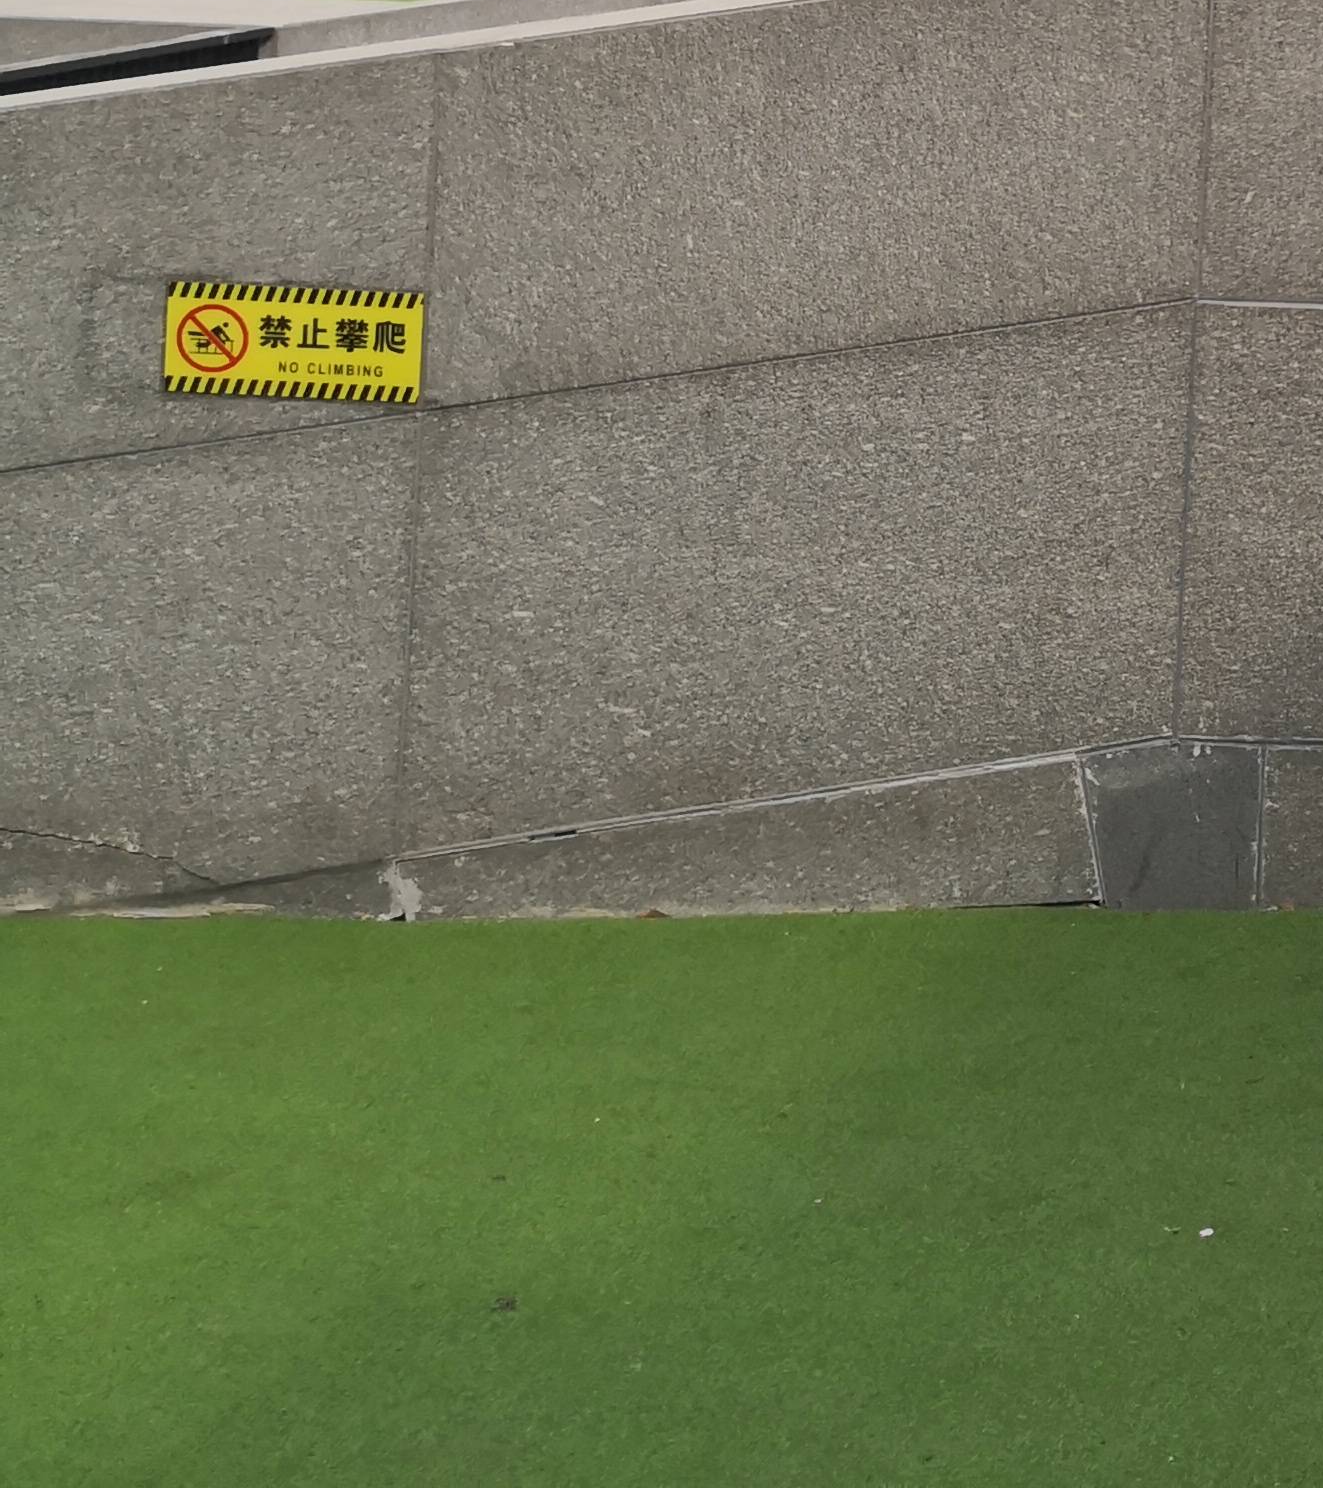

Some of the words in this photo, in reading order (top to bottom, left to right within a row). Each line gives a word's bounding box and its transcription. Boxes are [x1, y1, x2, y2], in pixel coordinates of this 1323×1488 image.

[259, 315, 406, 354] 禁止攀爬
[278, 361, 299, 373] NO
[307, 363, 384, 377] CLIMBING
